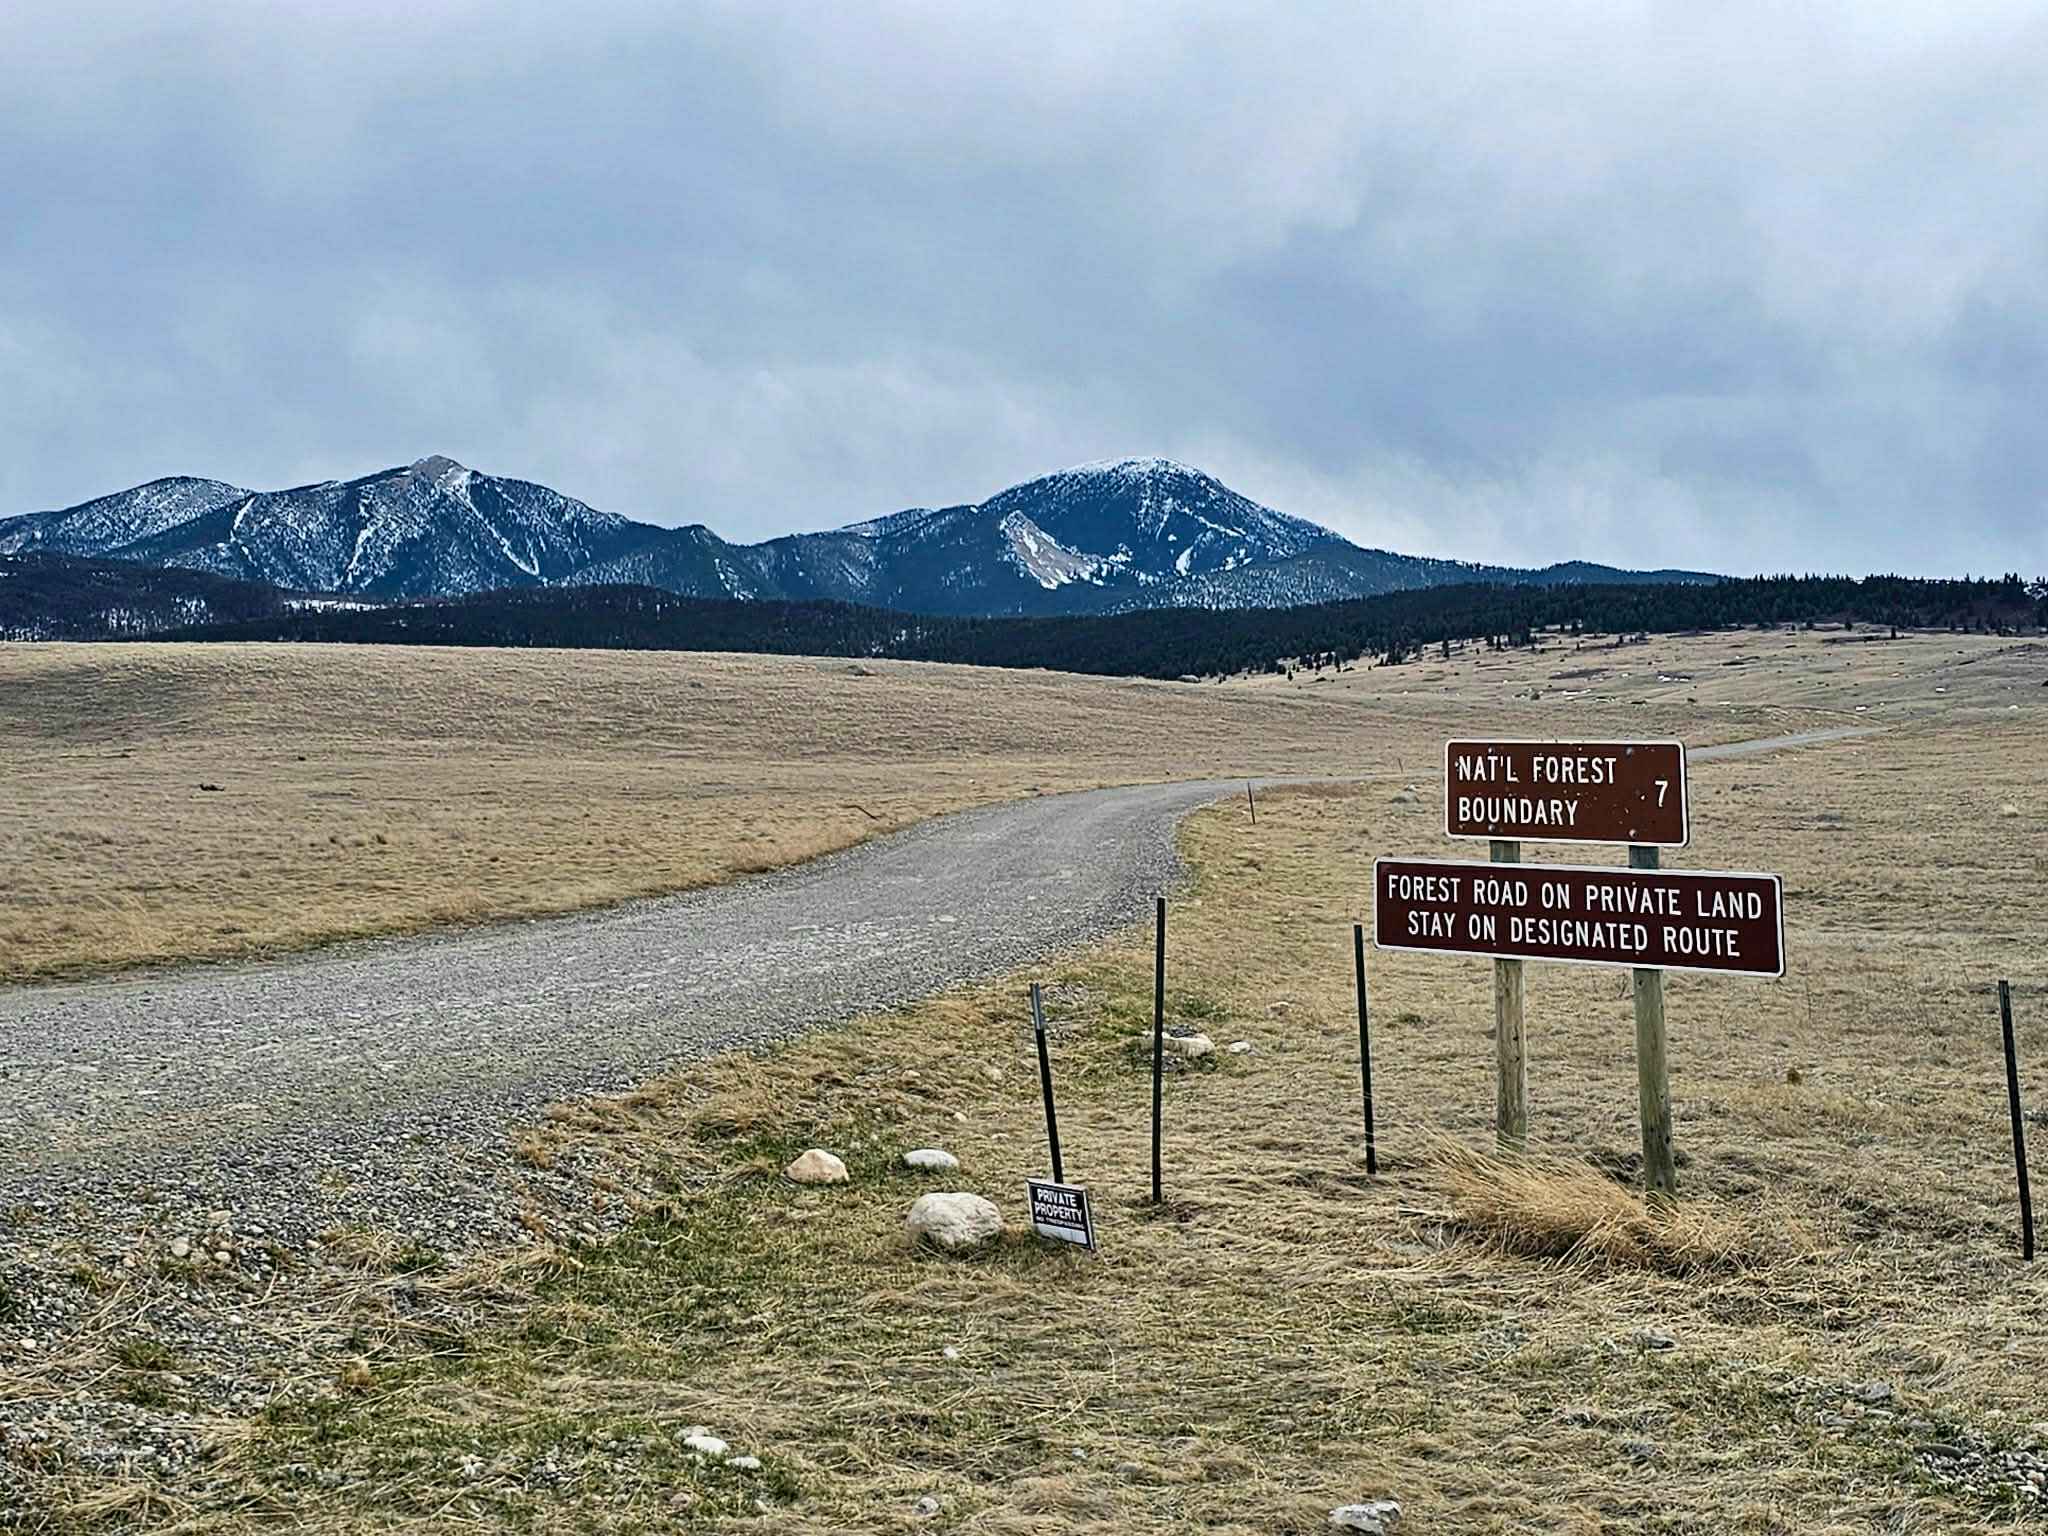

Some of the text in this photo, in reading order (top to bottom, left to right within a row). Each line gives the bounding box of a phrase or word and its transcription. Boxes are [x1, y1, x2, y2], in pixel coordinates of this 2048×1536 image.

[1457, 755, 1617, 785] NAT'L FOREST
[1654, 780, 1669, 808] 7
[1458, 797, 1578, 826] BOUNDARY
[1387, 874, 1762, 919] FOREST ROAD ON PRIVATE LAND
[1407, 910, 1741, 957] STAY ON DESIGNATED ROUTE
[1034, 1201, 1082, 1222] PROPERTY
[1037, 1188, 1077, 1207] PRIVATE
